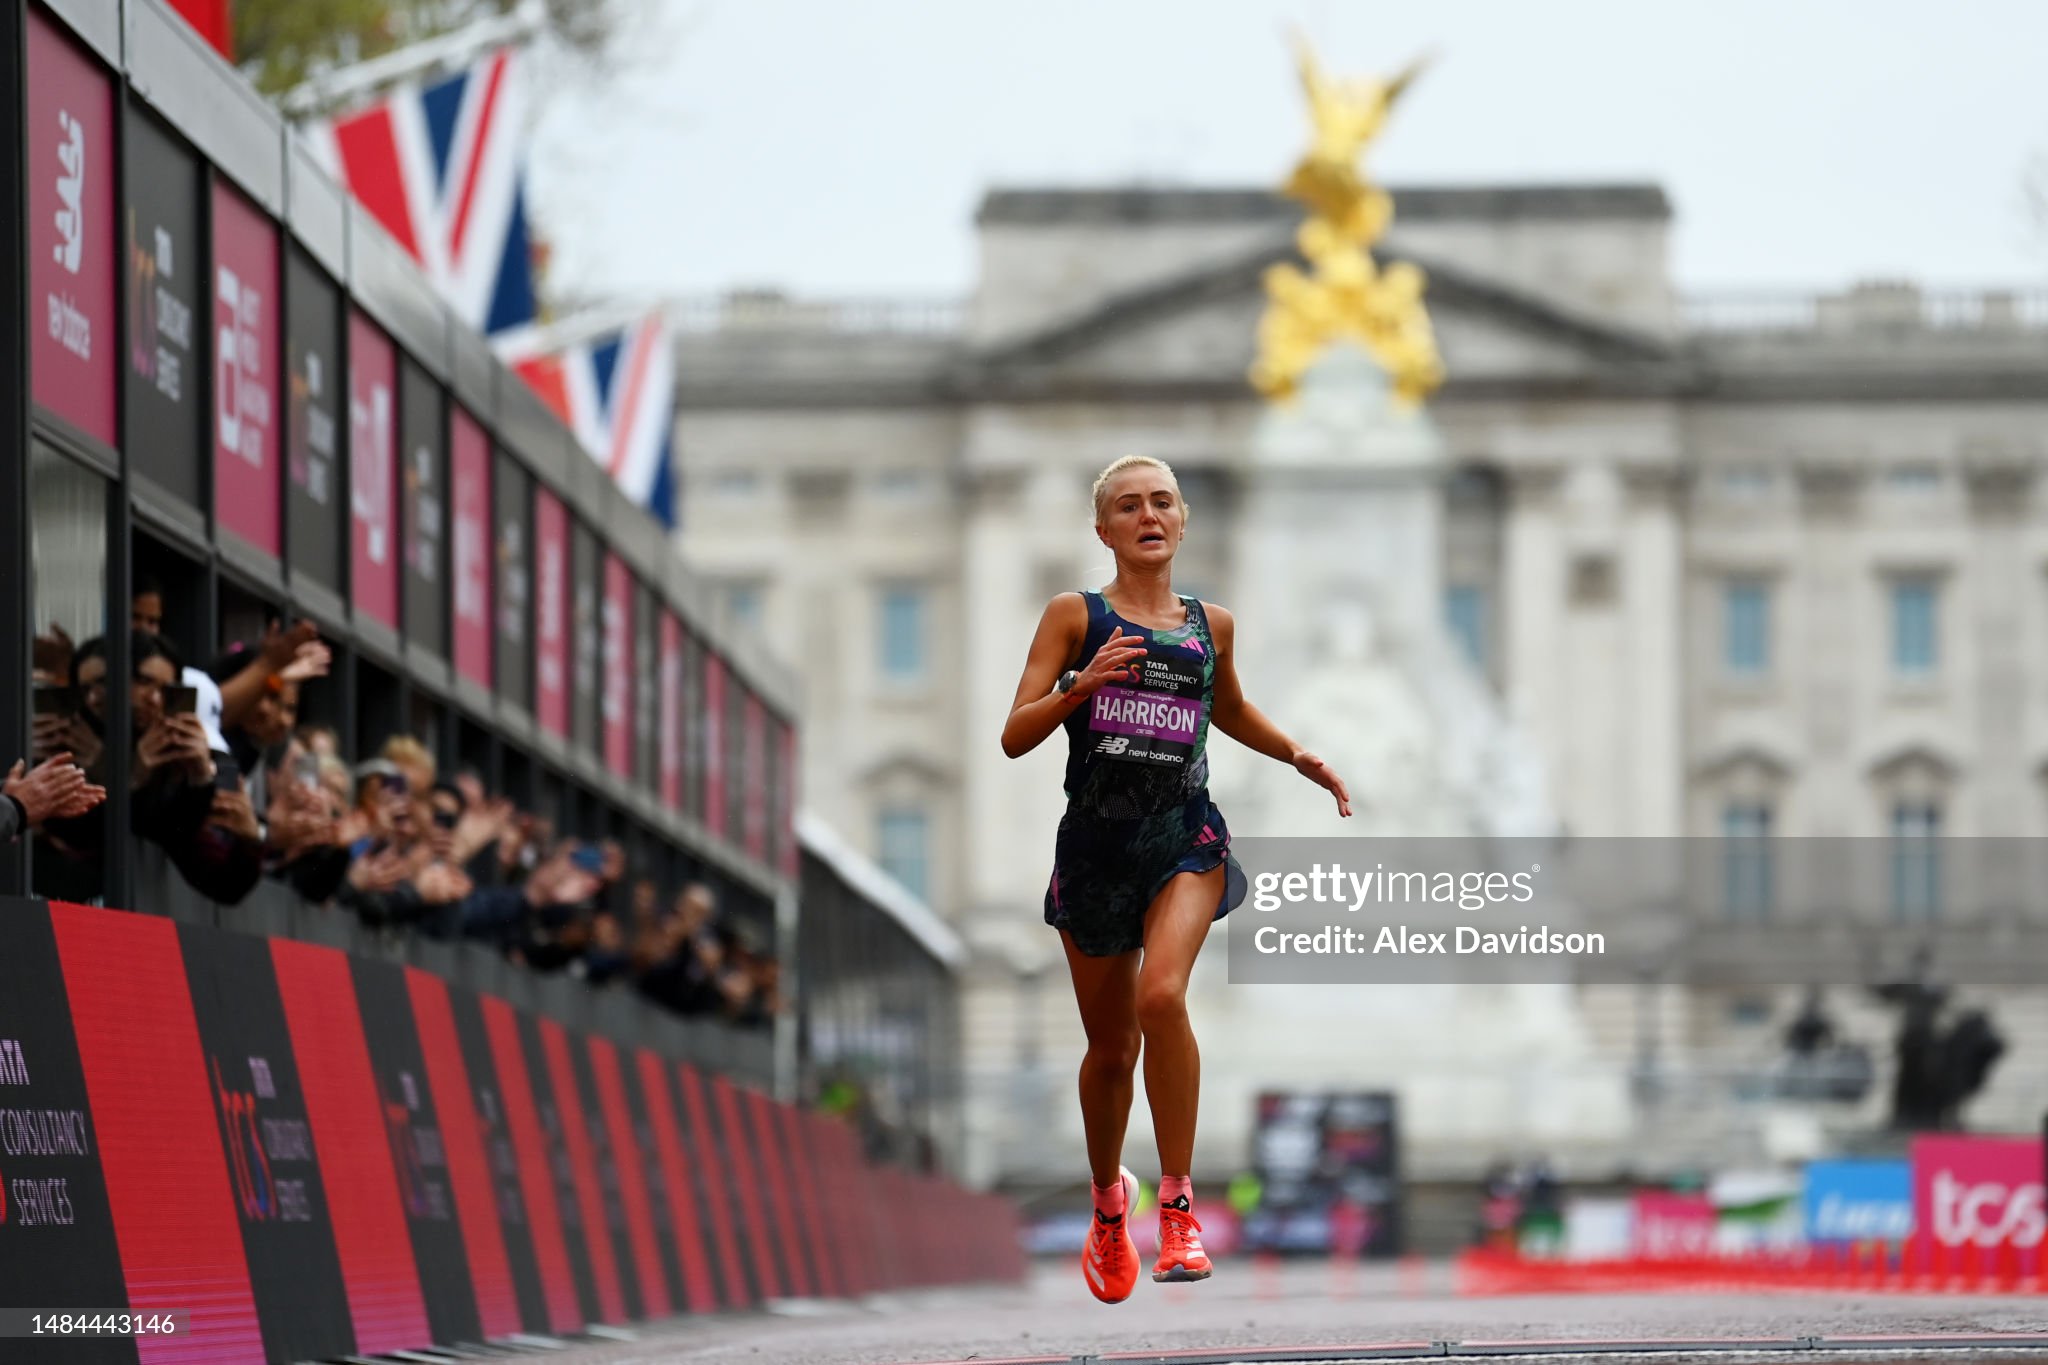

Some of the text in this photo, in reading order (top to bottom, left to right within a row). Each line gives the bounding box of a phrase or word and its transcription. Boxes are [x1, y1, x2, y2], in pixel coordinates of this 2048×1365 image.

[1144, 669, 1198, 685] CONSULTANCY
[1145, 660, 1168, 671] TATA
[1143, 678, 1179, 690] SERVICES
[1095, 695, 1196, 733] HARRISON
[1128, 749, 1148, 758] new
[0, 1040, 31, 1086] ATA
[0, 1108, 89, 1156] CONSULTANCY
[12, 1177, 75, 1226] SERVICES
